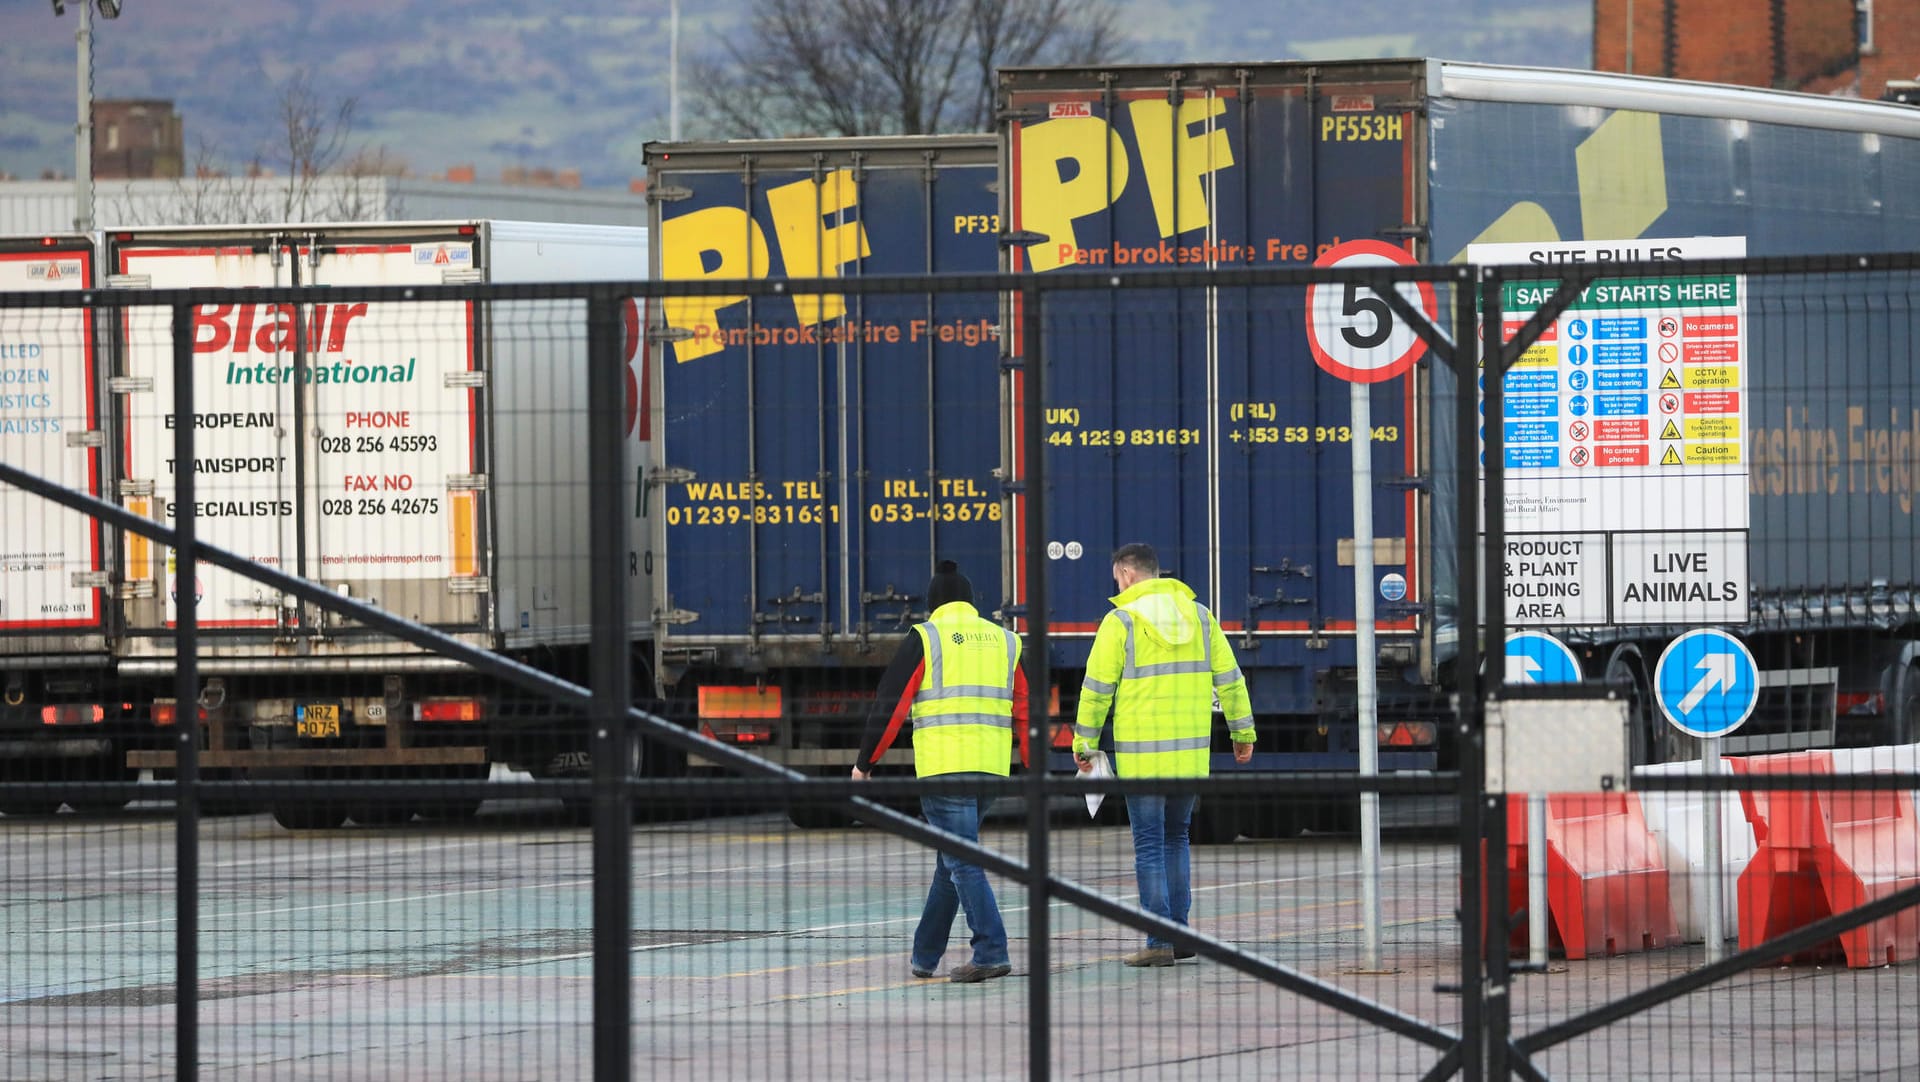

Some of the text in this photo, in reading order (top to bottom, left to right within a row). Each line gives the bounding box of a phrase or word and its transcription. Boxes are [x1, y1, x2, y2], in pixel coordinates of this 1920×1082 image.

[1051, 104, 1089, 116] SDC
[1322, 116, 1402, 141] PF553H
[1020, 97, 1234, 273] PF
[662, 169, 872, 364] PF
[1596, 284, 1671, 302] STARTS
[1677, 282, 1731, 300] HERE
[1341, 281, 1393, 348] 5
[192, 299, 368, 354] Blair
[226, 358, 416, 384] International
[1719, 368, 1727, 376] in
[1692, 378, 1730, 386] operation
[165, 412, 274, 429] EROPEAN
[346, 411, 410, 428] PHONE
[1230, 402, 1276, 422] (IRL)
[1080, 430, 1126, 446] 1239
[1131, 429, 1200, 445] 831631
[1284, 426, 1308, 442] 53
[321, 435, 438, 453] 028 256 45593
[1695, 446, 1729, 454] Caution
[166, 457, 286, 473] TANSPORT
[344, 474, 412, 492] FAX NO
[884, 479, 988, 498] IRL. TEL.
[166, 501, 292, 518] SECIALISTS
[323, 498, 438, 516] 028 256 42675
[667, 504, 840, 526] 01239-831631
[322, 554, 345, 565] Email:
[1653, 553, 1708, 573] LIVE
[1504, 562, 1578, 576] & PLANT
[1624, 581, 1738, 602] ANIMALS
[1516, 604, 1566, 618] AREA
[305, 706, 332, 720] NRZ
[368, 707, 382, 716] GB
[301, 721, 336, 735] 3075
